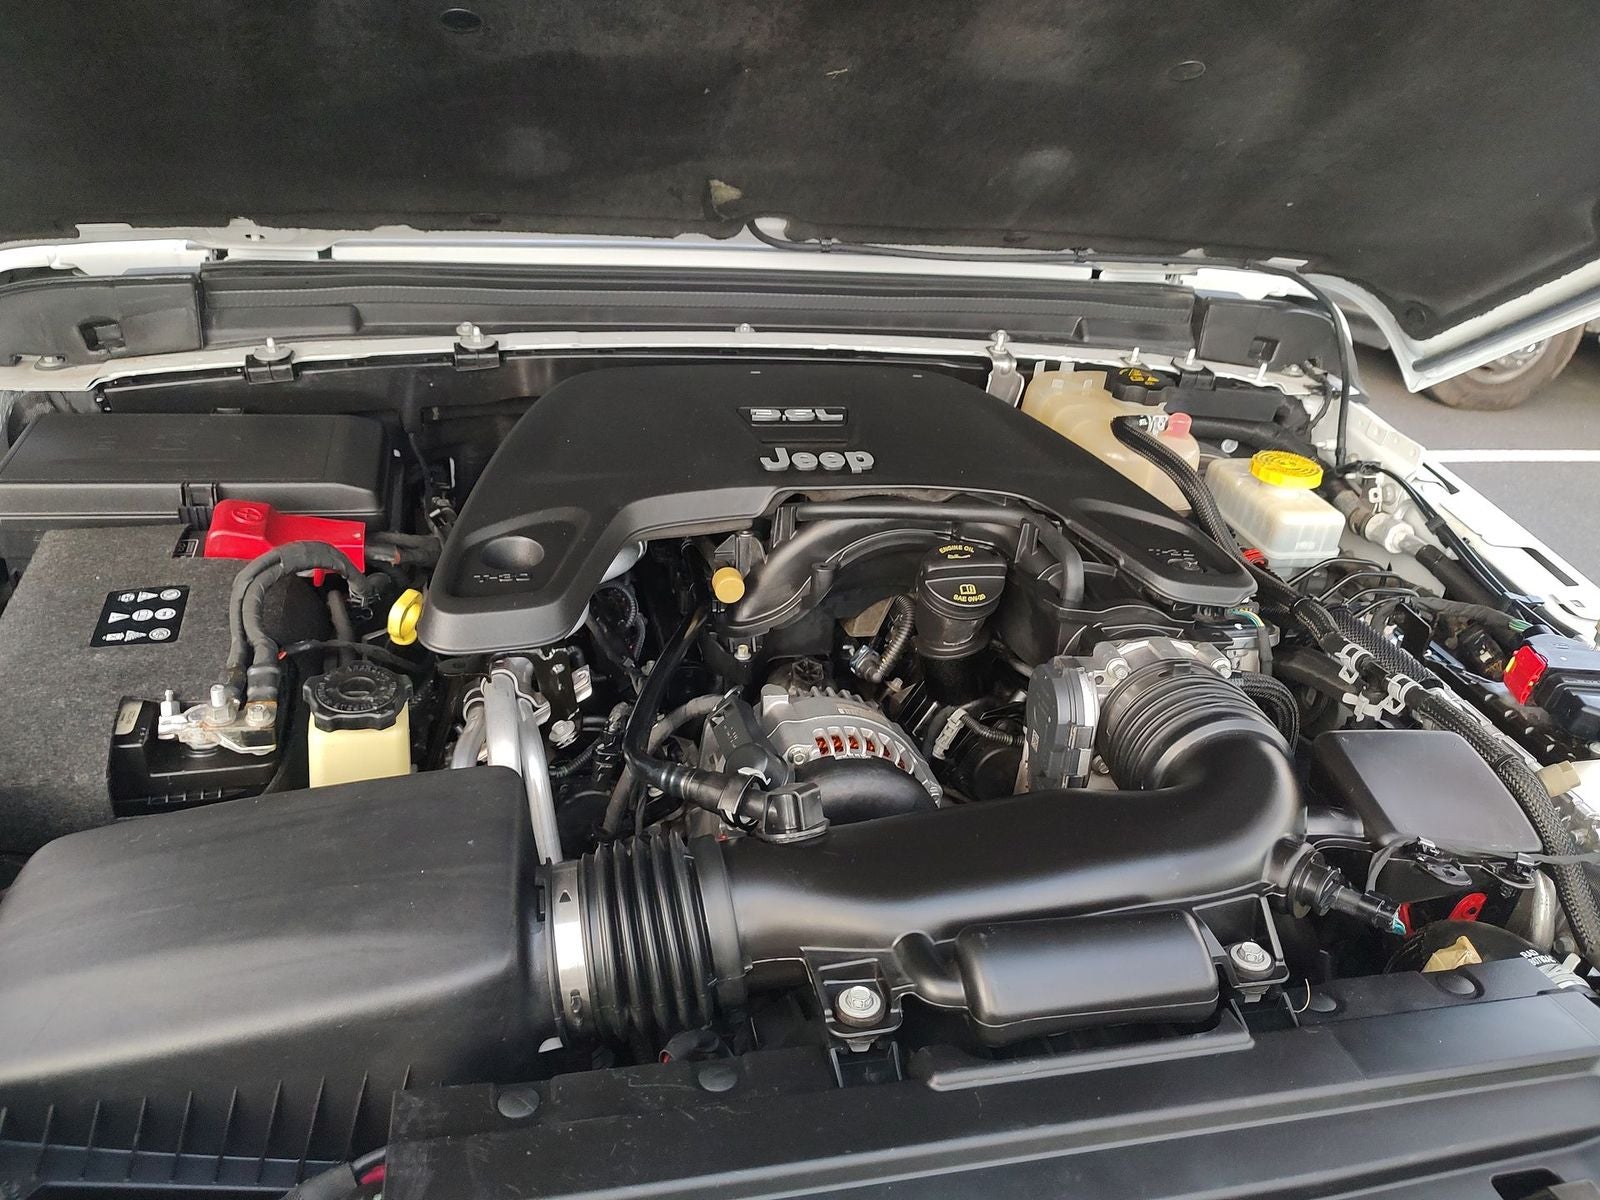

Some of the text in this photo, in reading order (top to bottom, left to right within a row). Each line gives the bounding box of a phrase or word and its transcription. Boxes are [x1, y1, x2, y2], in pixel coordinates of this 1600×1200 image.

[759, 447, 875, 474] Jeep
[938, 544, 975, 554] ENGINE OIL
